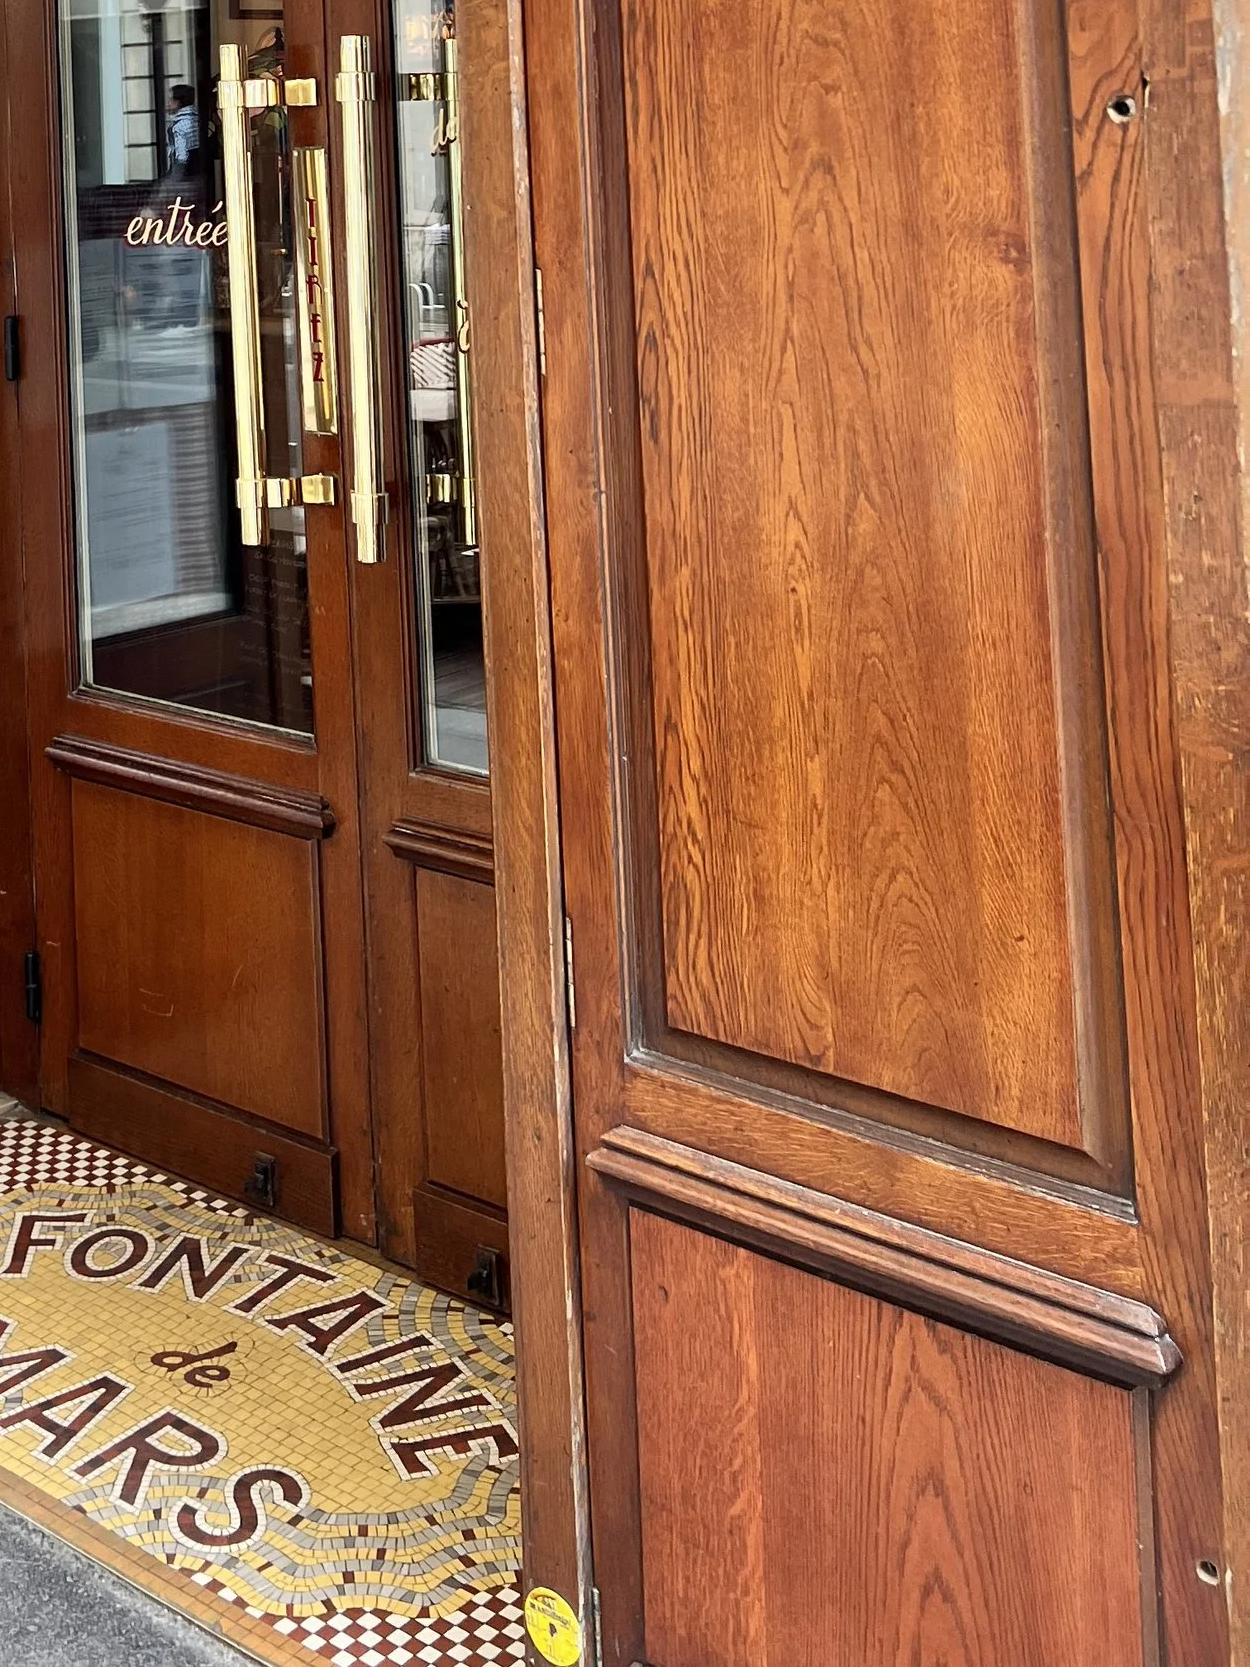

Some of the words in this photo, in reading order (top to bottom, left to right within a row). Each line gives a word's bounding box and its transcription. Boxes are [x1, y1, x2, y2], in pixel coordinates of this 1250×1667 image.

[123, 196, 228, 246] entrée
[305, 197, 325, 383] TIREZ
[2, 1211, 519, 1480] FONTAINE
[150, 1339, 237, 1389] de
